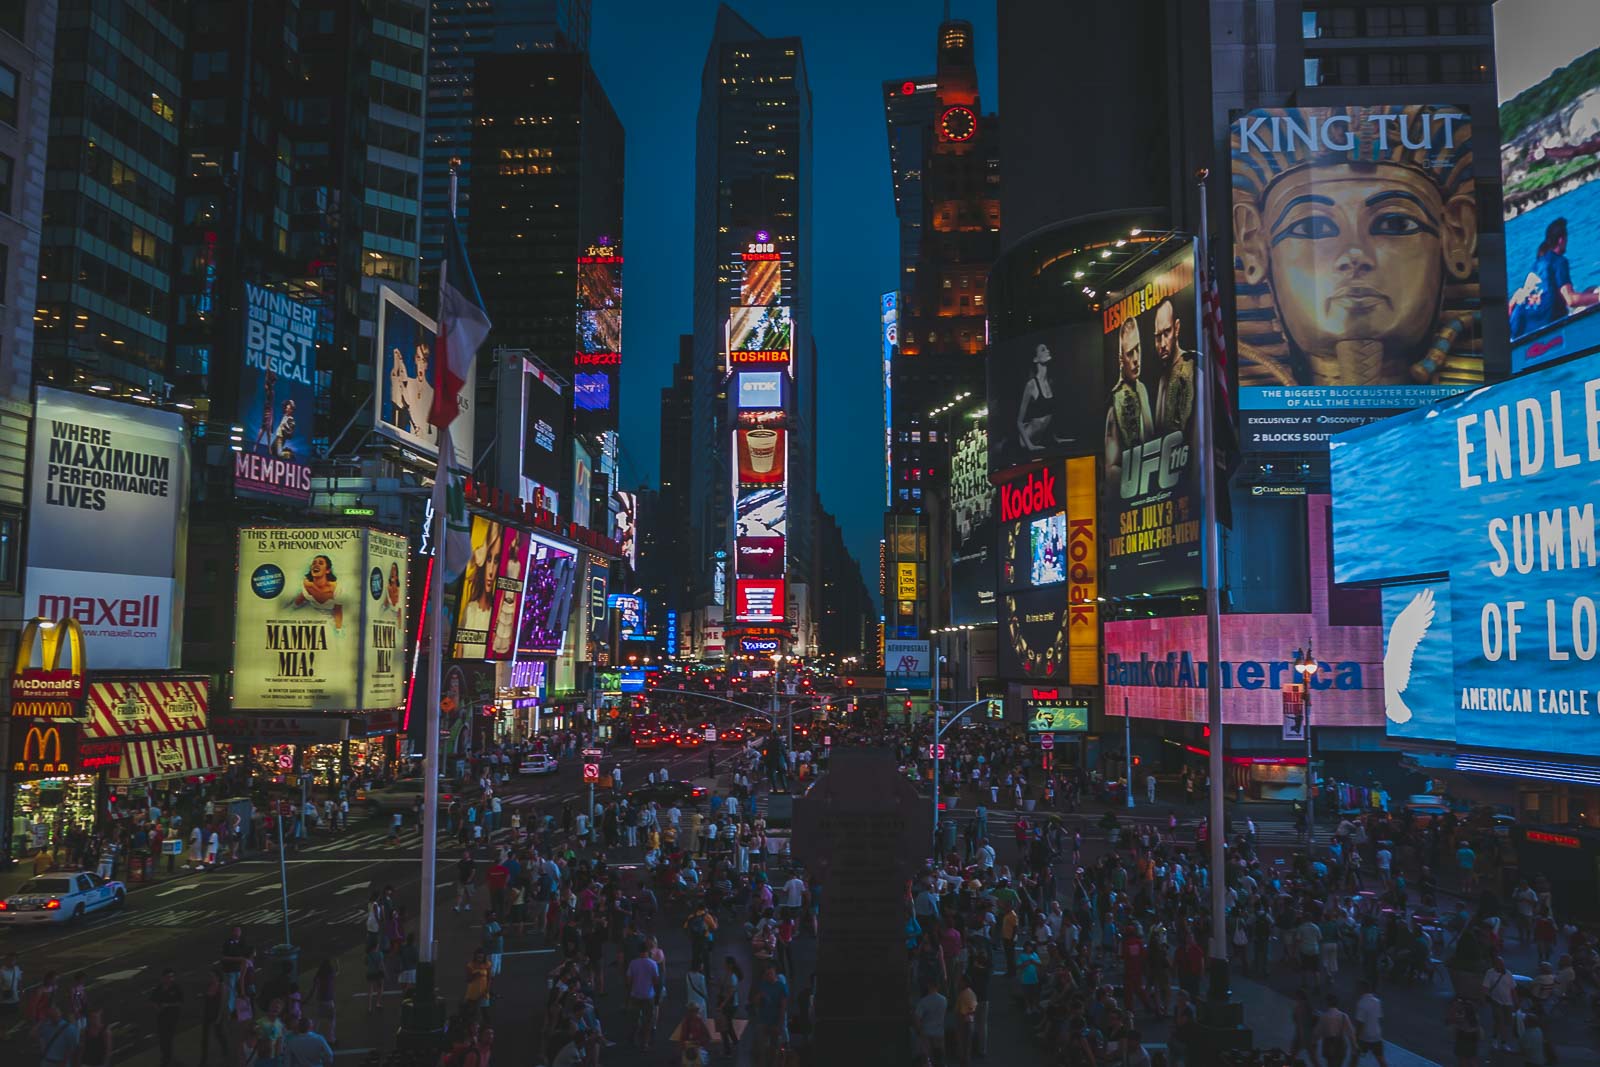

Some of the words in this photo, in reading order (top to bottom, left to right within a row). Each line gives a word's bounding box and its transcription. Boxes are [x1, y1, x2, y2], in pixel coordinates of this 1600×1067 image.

[1239, 115, 1355, 153] KING
[1367, 113, 1463, 151] TUT
[742, 253, 781, 261] TOSHIBA
[245, 281, 317, 328] WINNER!
[1103, 290, 1141, 335] LESNAR
[247, 318, 313, 367] BEST
[731, 351, 789, 363] TOSHIBA
[246, 347, 312, 386] MUSICAL
[1261, 389, 1282, 398] THE
[1284, 389, 1328, 398] BIGGEST
[1329, 388, 1404, 398] BLOCKBUSTER
[1286, 399, 1301, 407] OF
[1303, 399, 1323, 407] ALL
[1325, 399, 1351, 407] TIME
[1352, 398, 1400, 406] RETURNS
[1403, 398, 1417, 406] TO
[51, 420, 112, 447] WHERE
[1247, 417, 1300, 425] EXCLUSIVELY
[1252, 434, 1261, 442] 2
[1262, 434, 1302, 442] BLOCKS
[48, 438, 170, 481] MAXIMUM
[235, 451, 312, 491] MEMPHIS
[1120, 431, 1184, 500] UFC
[1171, 445, 1189, 471] 116
[47, 463, 169, 498] PERFORMANCE
[1001, 467, 1057, 523] Kodak
[46, 482, 106, 512] LIVES
[1120, 509, 1141, 535] SAT.
[1142, 502, 1164, 531] JULY
[1166, 500, 1173, 527] 3
[258, 540, 267, 550] IS
[269, 541, 276, 550] A
[270, 531, 320, 540] FEEL-GOOD
[322, 529, 361, 540] MUSICAL
[1109, 535, 1126, 558] LIVE
[1126, 533, 1138, 554] ON
[1138, 519, 1199, 552] PAY-PER-VIEW
[1487, 503, 1598, 578] SUMM
[1069, 519, 1094, 626] Kodak
[37, 594, 160, 628] maxell
[265, 624, 328, 650] MAMMA
[372, 624, 396, 649] MAMMA
[1480, 600, 1526, 662] OF
[1545, 595, 1599, 662] LO
[277, 652, 315, 677] MIA!
[376, 650, 392, 673] MIA!
[1107, 652, 1154, 687] Bank
[1154, 651, 1178, 687] of
[1177, 650, 1363, 691] America
[12, 678, 81, 690] McDonald's
[23, 690, 70, 698] Restaurant
[1460, 687, 1533, 713] AMERICAN
[1538, 689, 1590, 715] EAGLE
